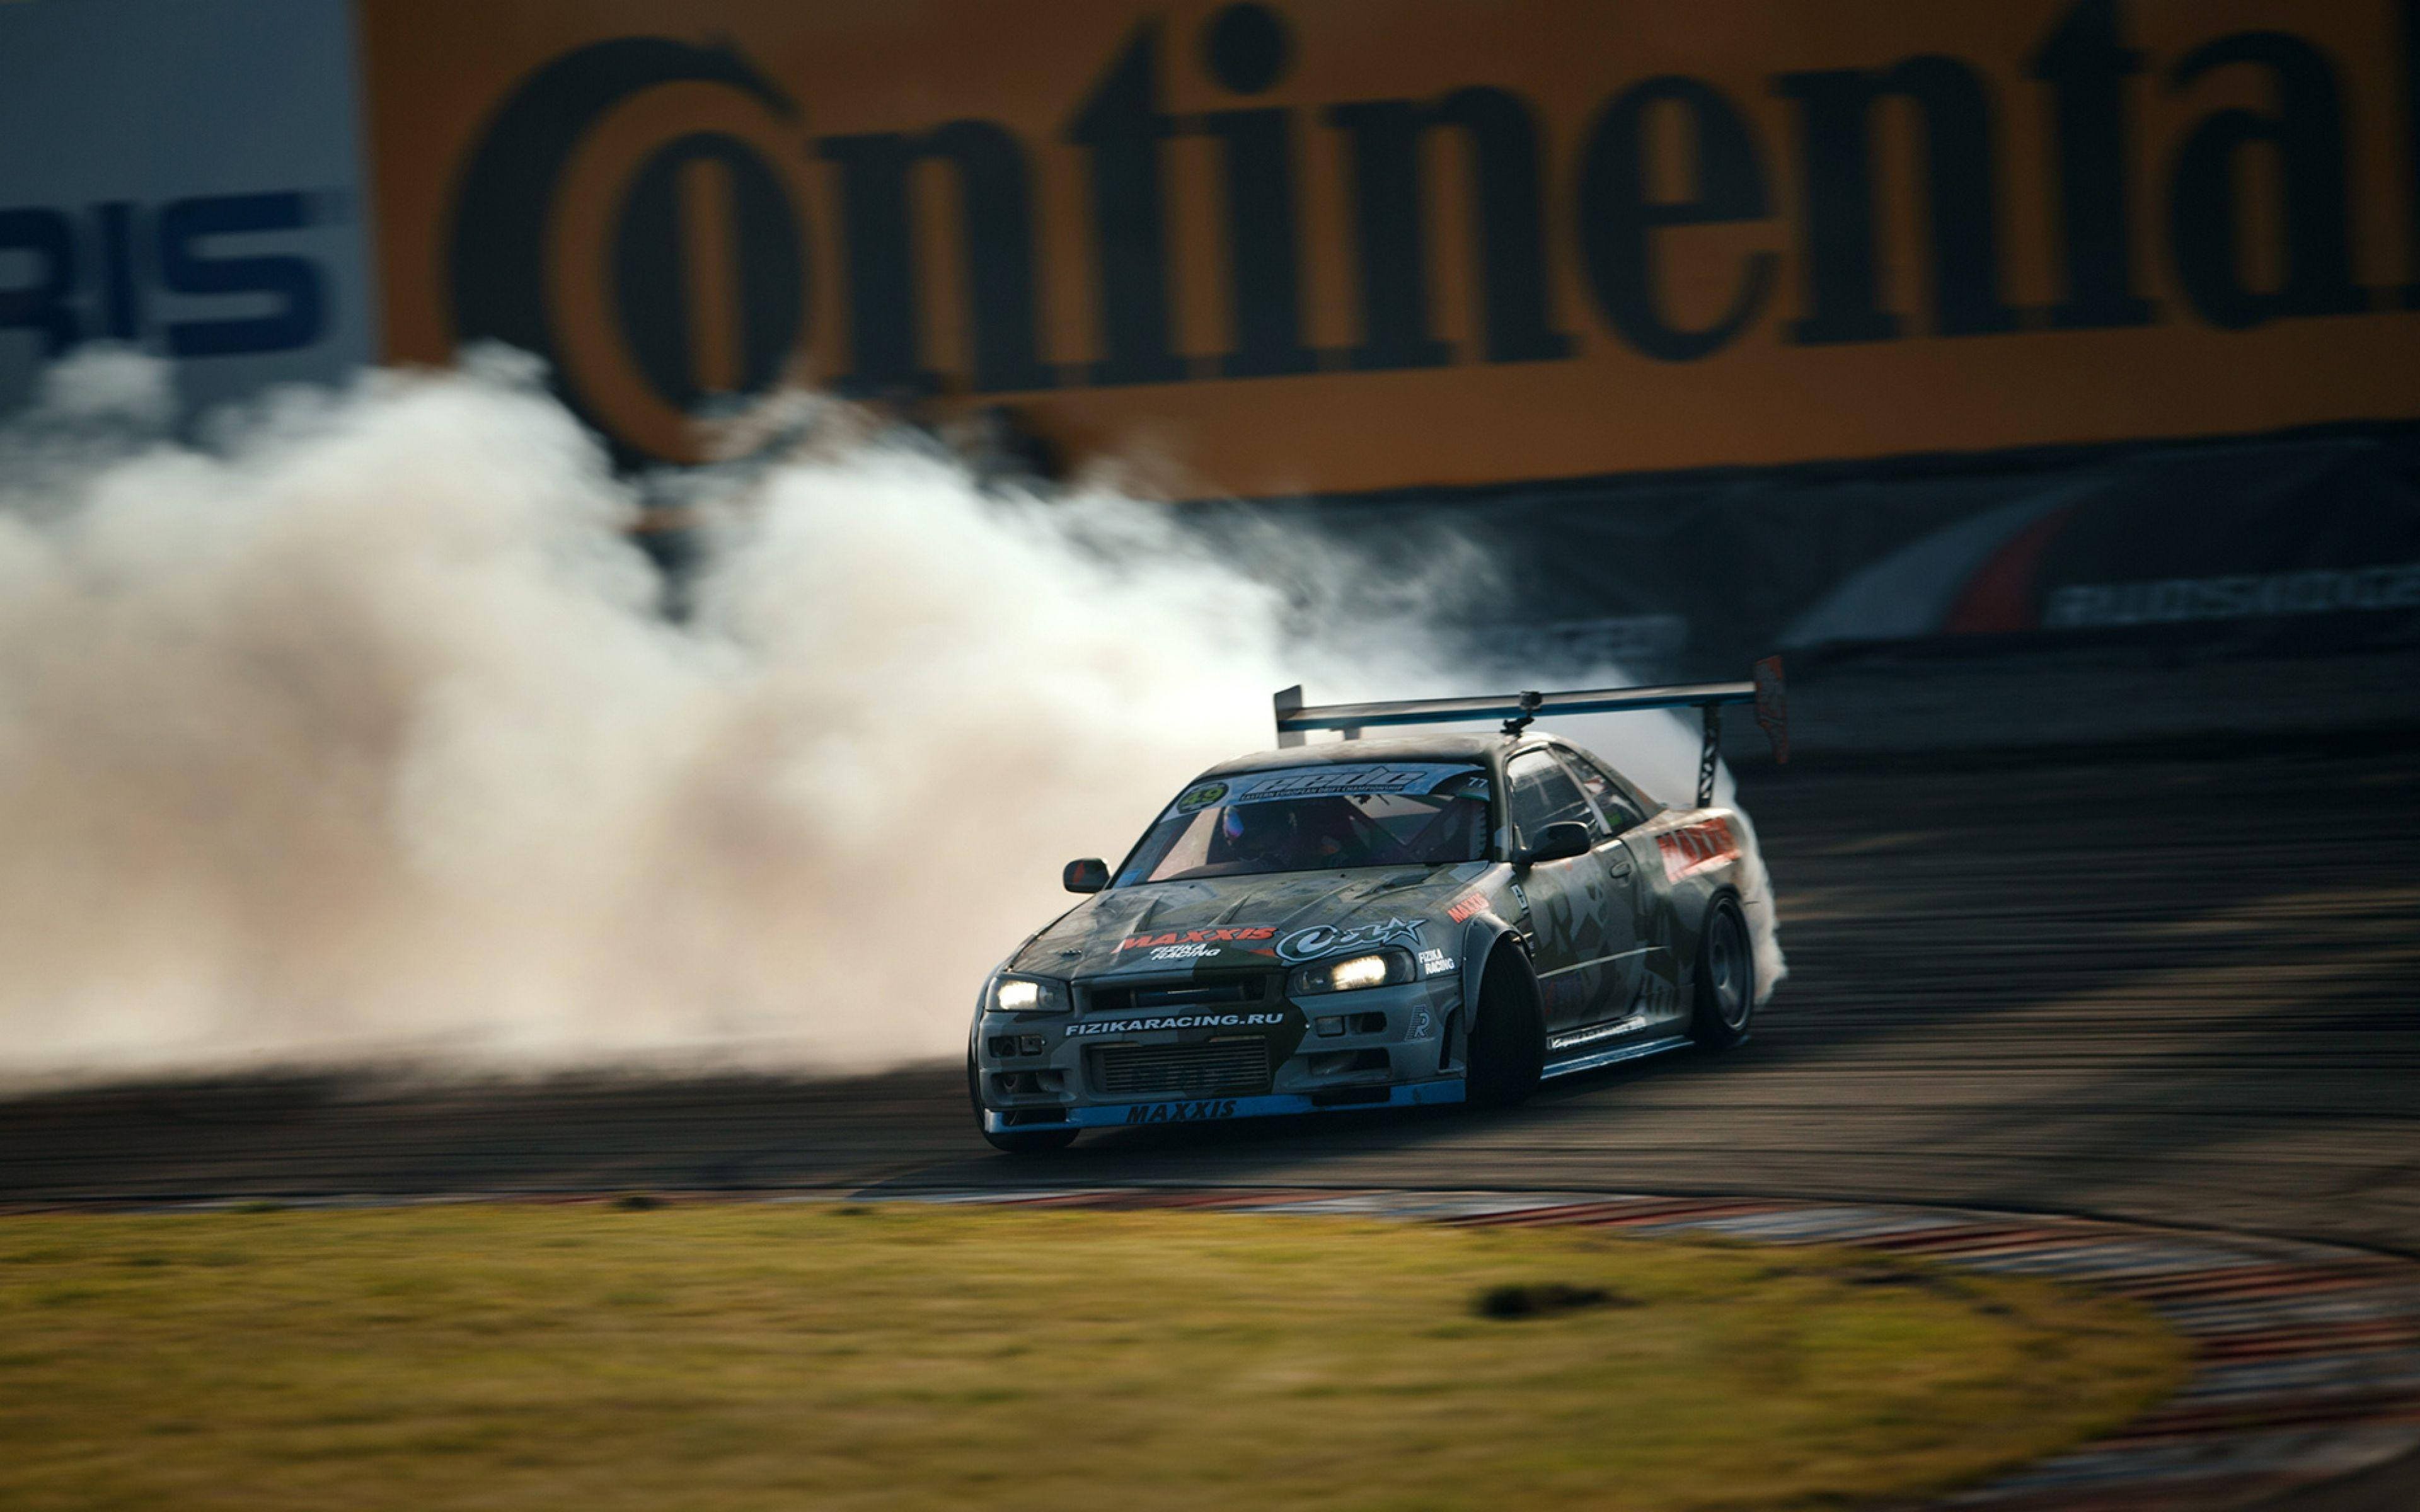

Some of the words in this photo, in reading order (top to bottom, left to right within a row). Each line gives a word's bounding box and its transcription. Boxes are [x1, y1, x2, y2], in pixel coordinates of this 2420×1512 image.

[447, 0, 2420, 467] Continenta
[1181, 787, 1223, 805] 49
[1240, 791, 1275, 801] EASTERN
[1276, 788, 1318, 796] EUROPEAN
[1340, 784, 1404, 793] CHAMPIONSHIP
[1111, 927, 1278, 954] MAXXIS
[1150, 943, 1207, 955] FIZIKA
[1151, 949, 1221, 961] RACING
[1418, 948, 1443, 964] FIZIKA
[1425, 957, 1456, 975] RACING
[1065, 1013, 1284, 1036] FIZIKARACING.RU
[1126, 1100, 1237, 1123] MAXXIS
